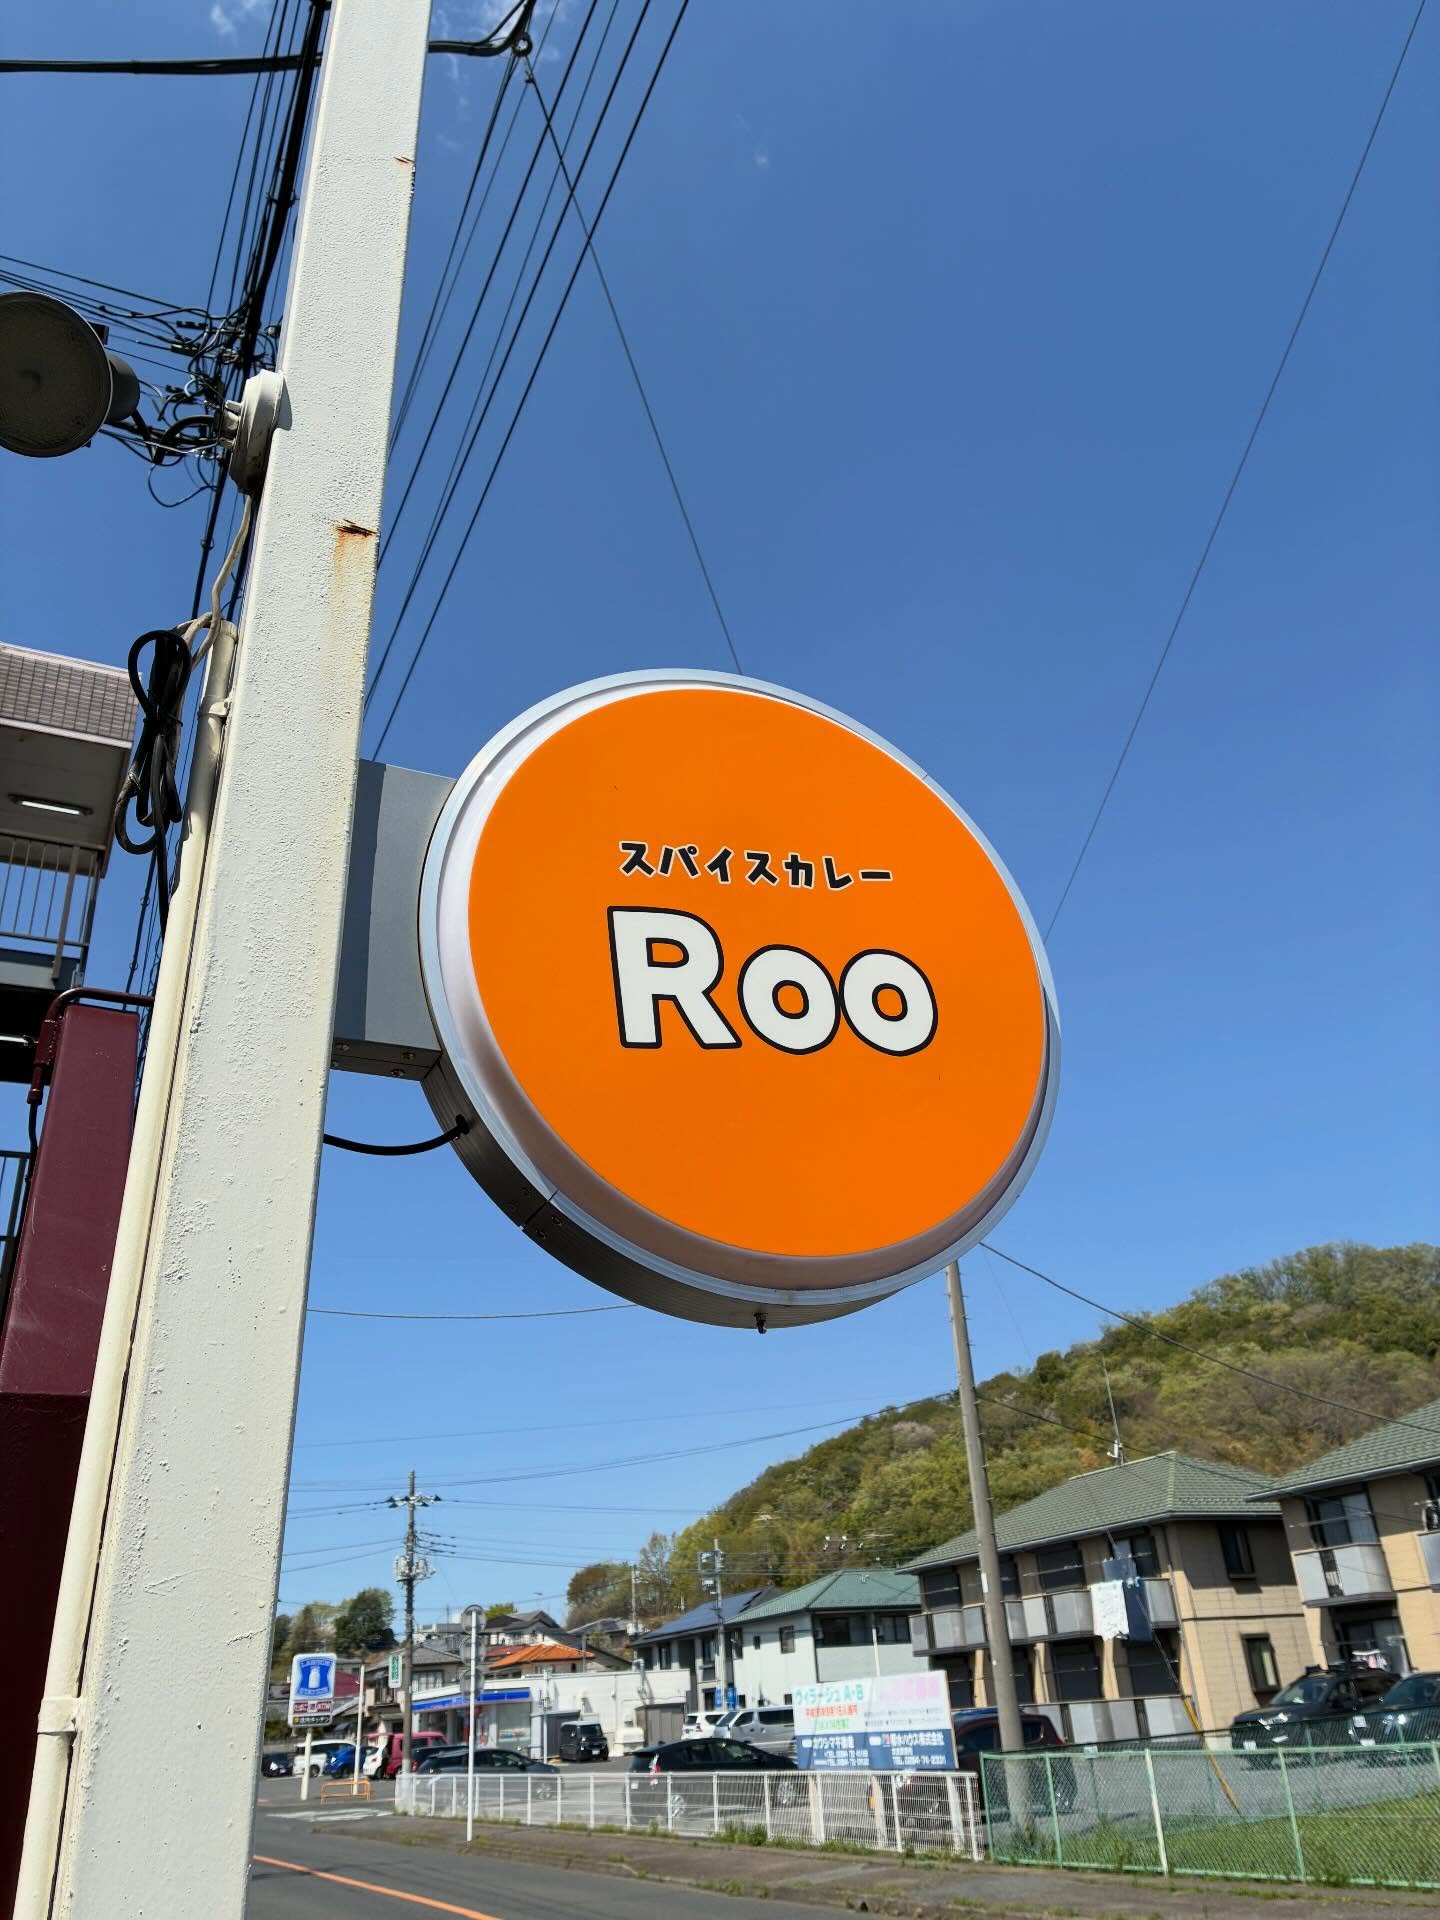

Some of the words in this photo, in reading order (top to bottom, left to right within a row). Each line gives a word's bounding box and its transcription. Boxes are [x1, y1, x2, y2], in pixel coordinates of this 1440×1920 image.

[619, 841, 893, 891] スパイスカレー
[607, 906, 938, 1057] Roo
